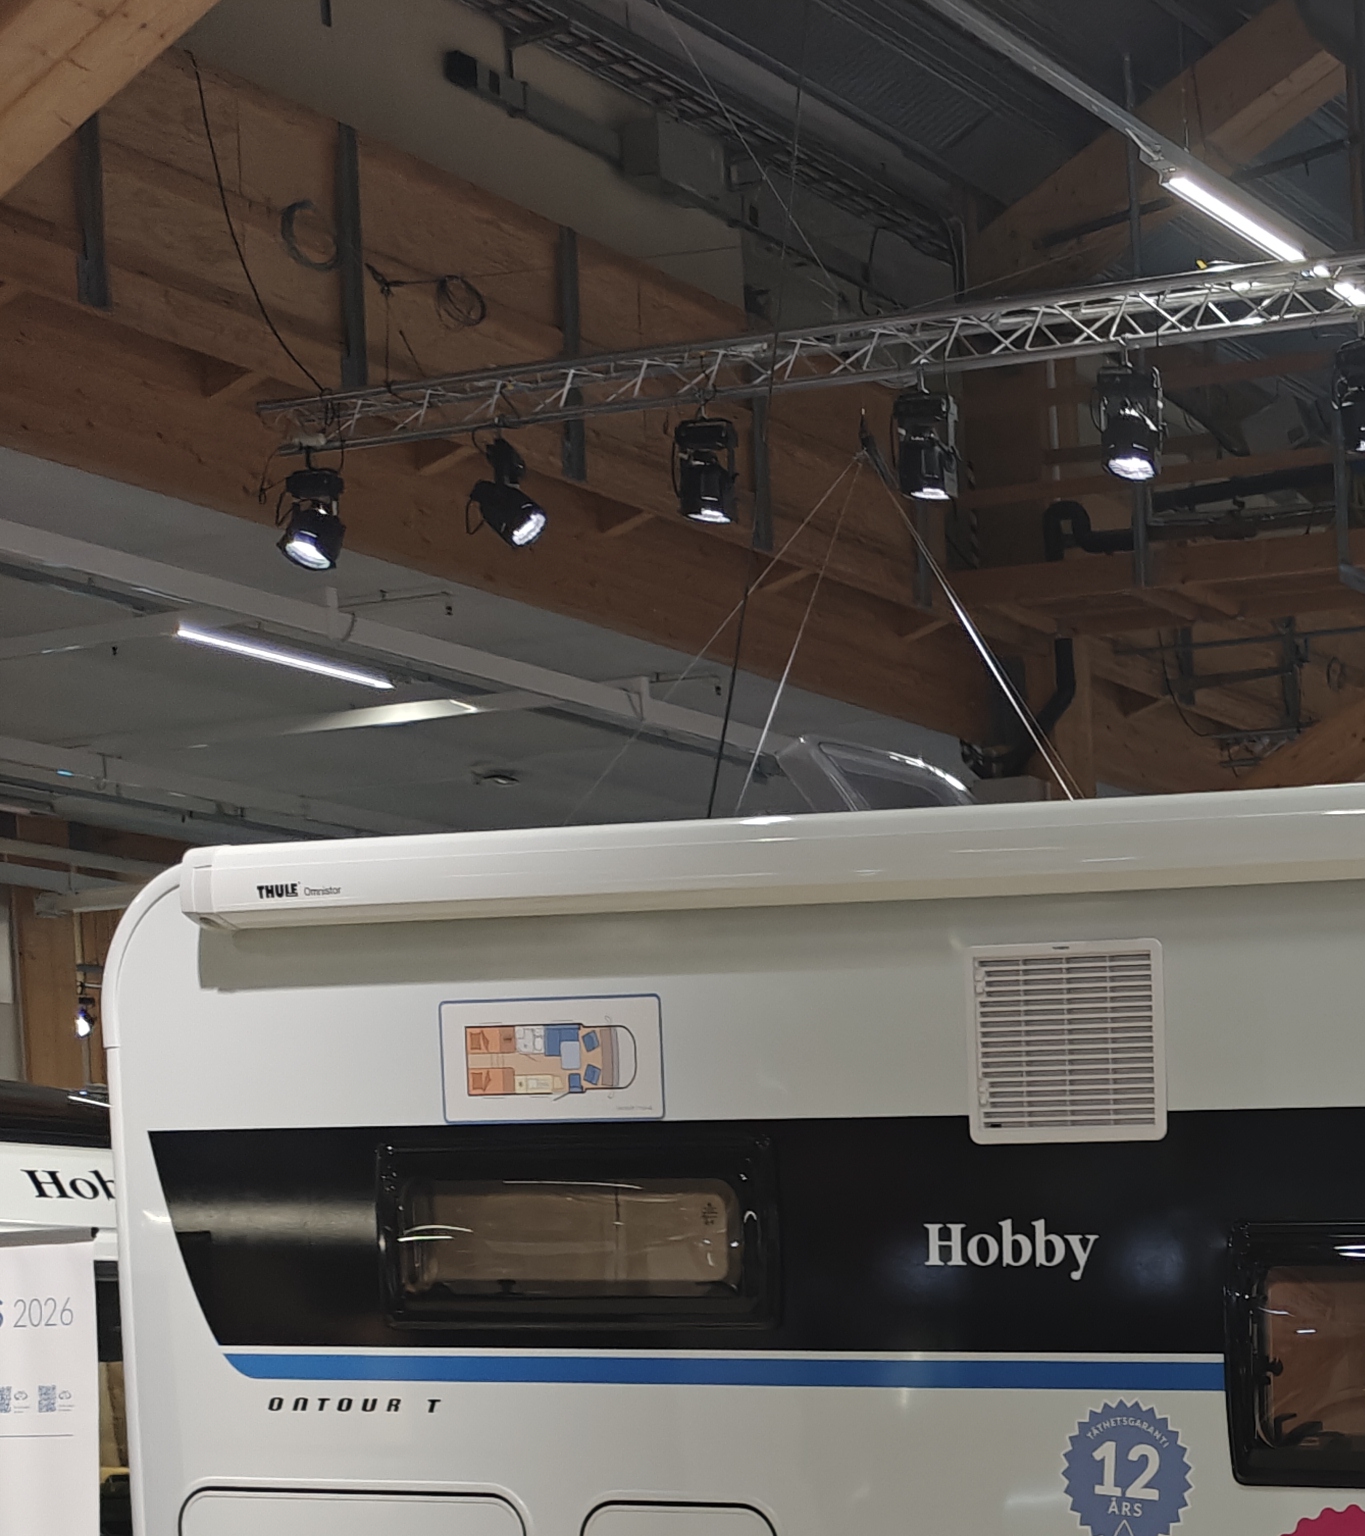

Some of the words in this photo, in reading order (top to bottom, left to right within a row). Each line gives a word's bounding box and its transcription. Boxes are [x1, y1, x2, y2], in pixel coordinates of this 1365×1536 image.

[257, 883, 298, 899] THULE
[304, 886, 341, 896] Omnistor
[923, 1218, 1100, 1280] Hobby
[13, 1297, 74, 1328] 2026
[268, 1397, 401, 1412] ONTOUR
[427, 1399, 441, 1413] T
[1092, 1441, 1160, 1501] 12
[1107, 1497, 1143, 1517] ÅRS
